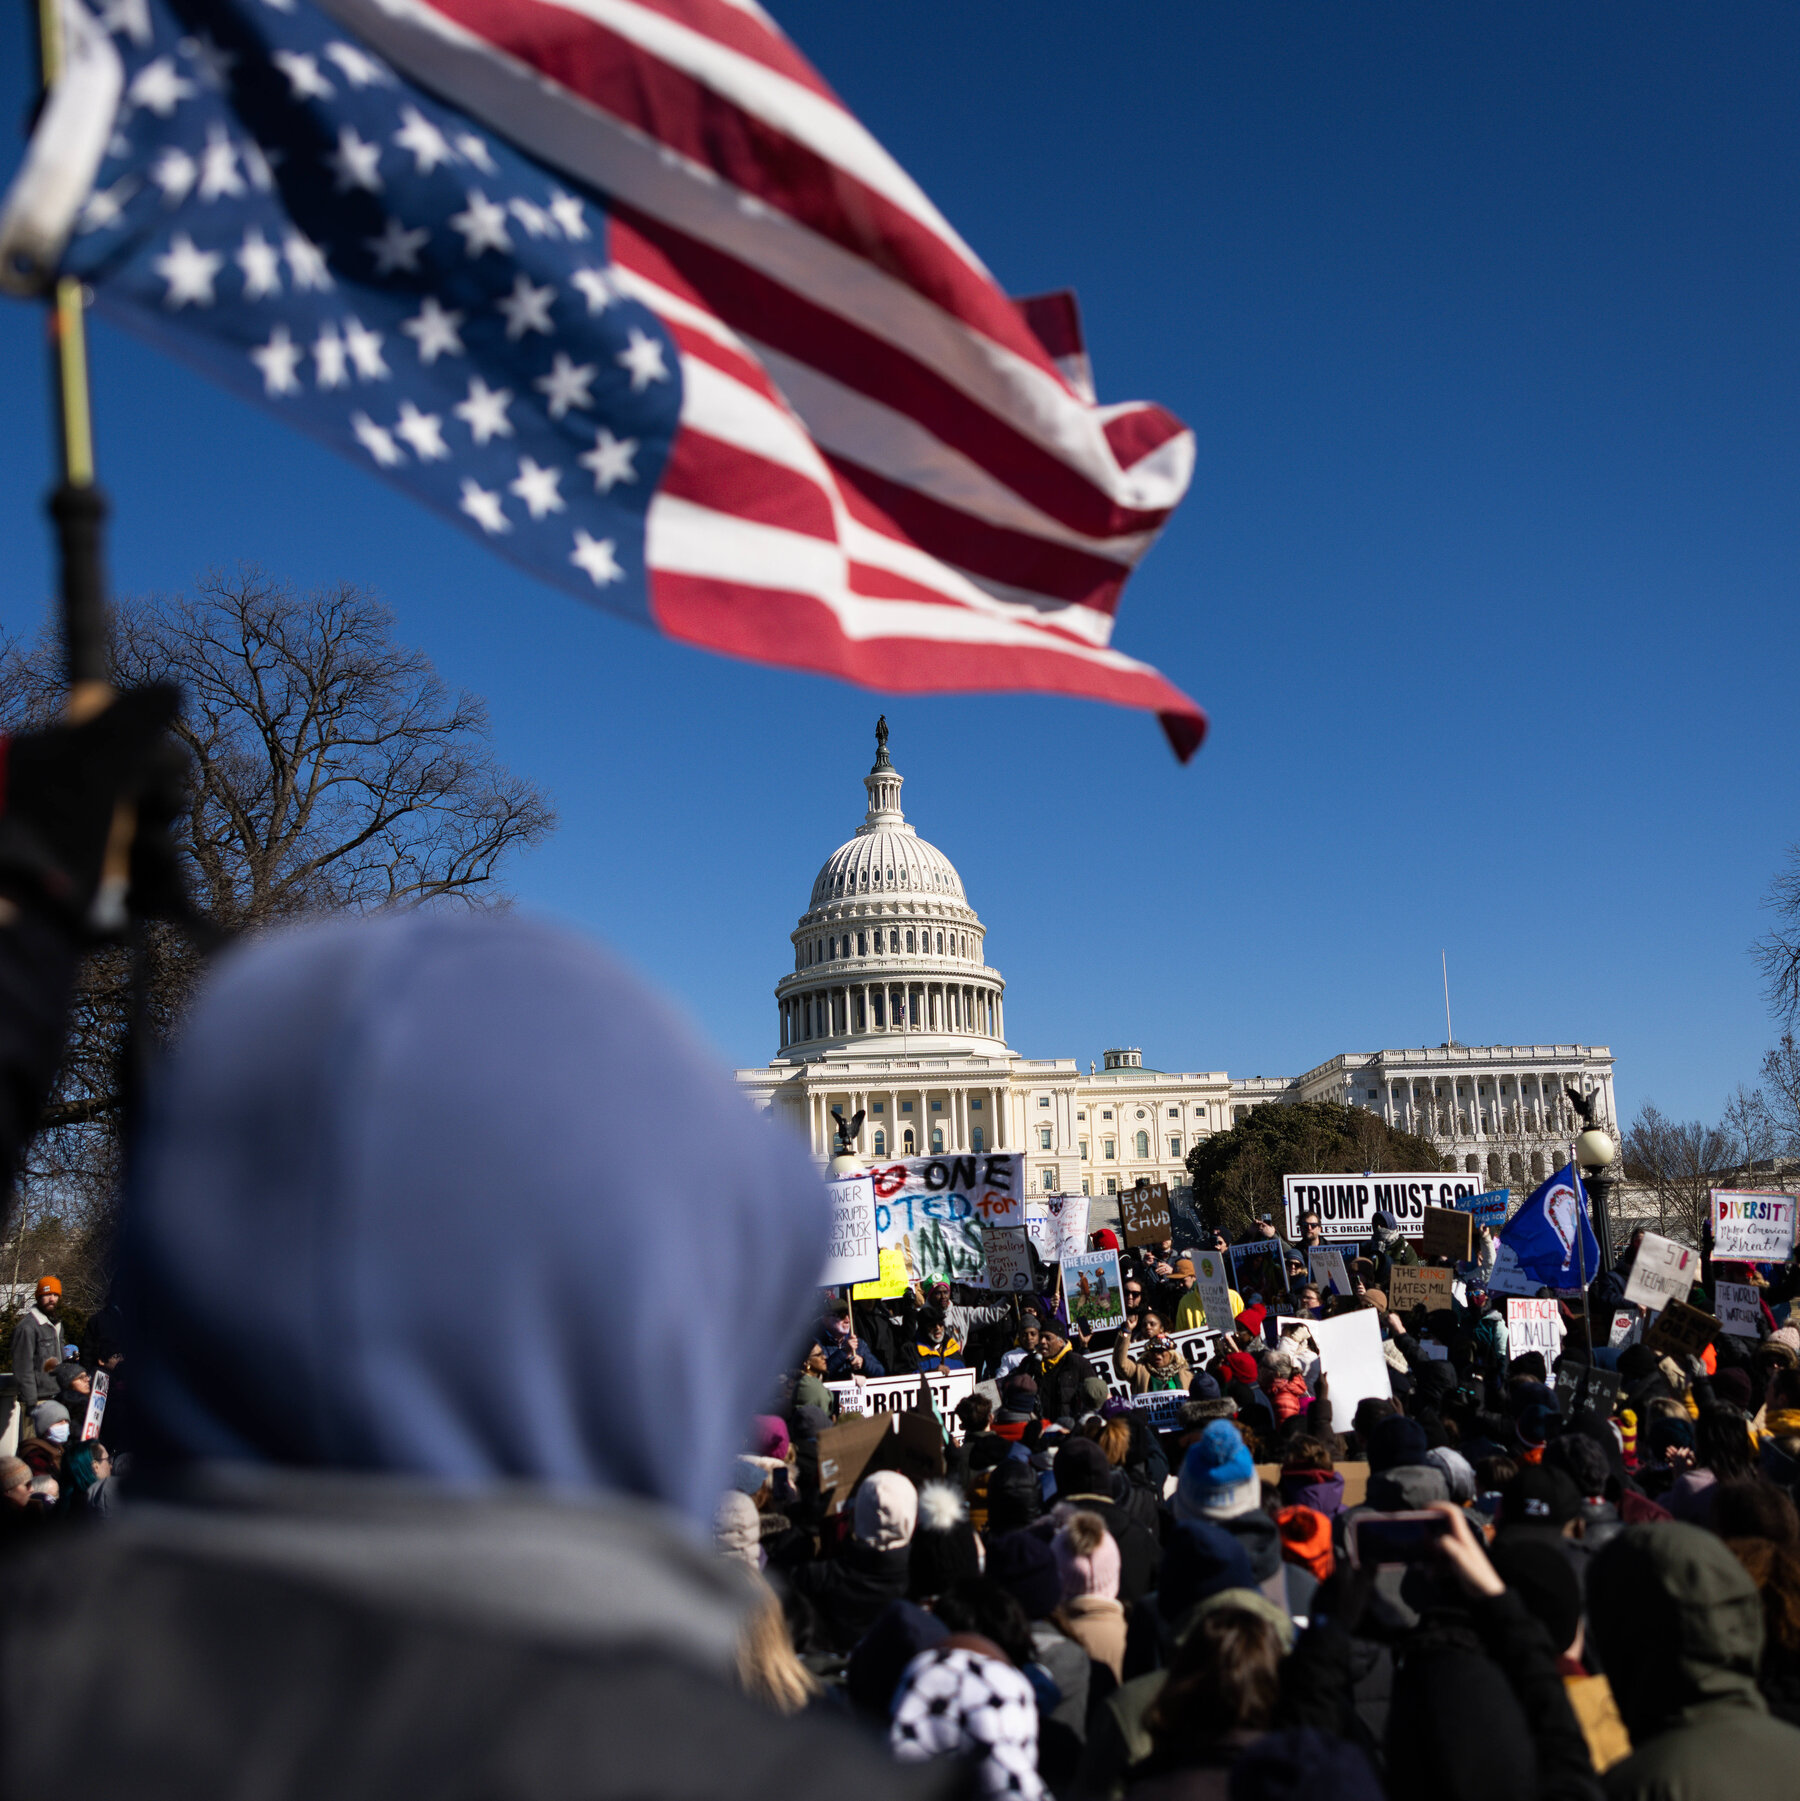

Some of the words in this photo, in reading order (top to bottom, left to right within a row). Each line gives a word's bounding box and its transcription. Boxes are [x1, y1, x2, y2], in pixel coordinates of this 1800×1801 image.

[924, 1155, 1012, 1191] ONE
[830, 1185, 862, 1203] OWER
[1294, 1184, 1369, 1221] TRUMP
[1374, 1183, 1433, 1219] MUST
[1457, 1199, 1471, 1209] WE
[1475, 1194, 1501, 1205] SAID
[875, 1193, 972, 1233] OTED
[976, 1191, 1017, 1219] for
[1125, 1204, 1137, 1217] IS
[1141, 1203, 1151, 1212] A
[1472, 1202, 1506, 1215] KINGS
[1719, 1201, 1793, 1222] DIVERSITY
[1126, 1210, 1170, 1231] CHUD
[846, 1221, 871, 1238] MUSK
[829, 1241, 855, 1258] ROVES
[856, 1237, 871, 1256] IT
[984, 1241, 1025, 1254] Stealing
[1233, 1247, 1246, 1257] THE
[1247, 1245, 1268, 1255] FACES
[1269, 1243, 1279, 1252] OF
[1346, 1246, 1355, 1256] OF
[1064, 1258, 1079, 1269] THE
[1080, 1253, 1104, 1267] FACES
[1104, 1252, 1116, 1262] OF
[1394, 1267, 1416, 1279] THE
[1419, 1268, 1446, 1280] KING
[1393, 1282, 1426, 1294] HATES
[1717, 1285, 1730, 1300] THE
[1733, 1287, 1758, 1304] WORLD
[1509, 1300, 1557, 1319] IMPEACH
[1109, 1315, 1123, 1328] AID
[1510, 1321, 1558, 1347] DONALD
[1137, 1397, 1148, 1406] WE
[1150, 1394, 1175, 1404] WON'T
